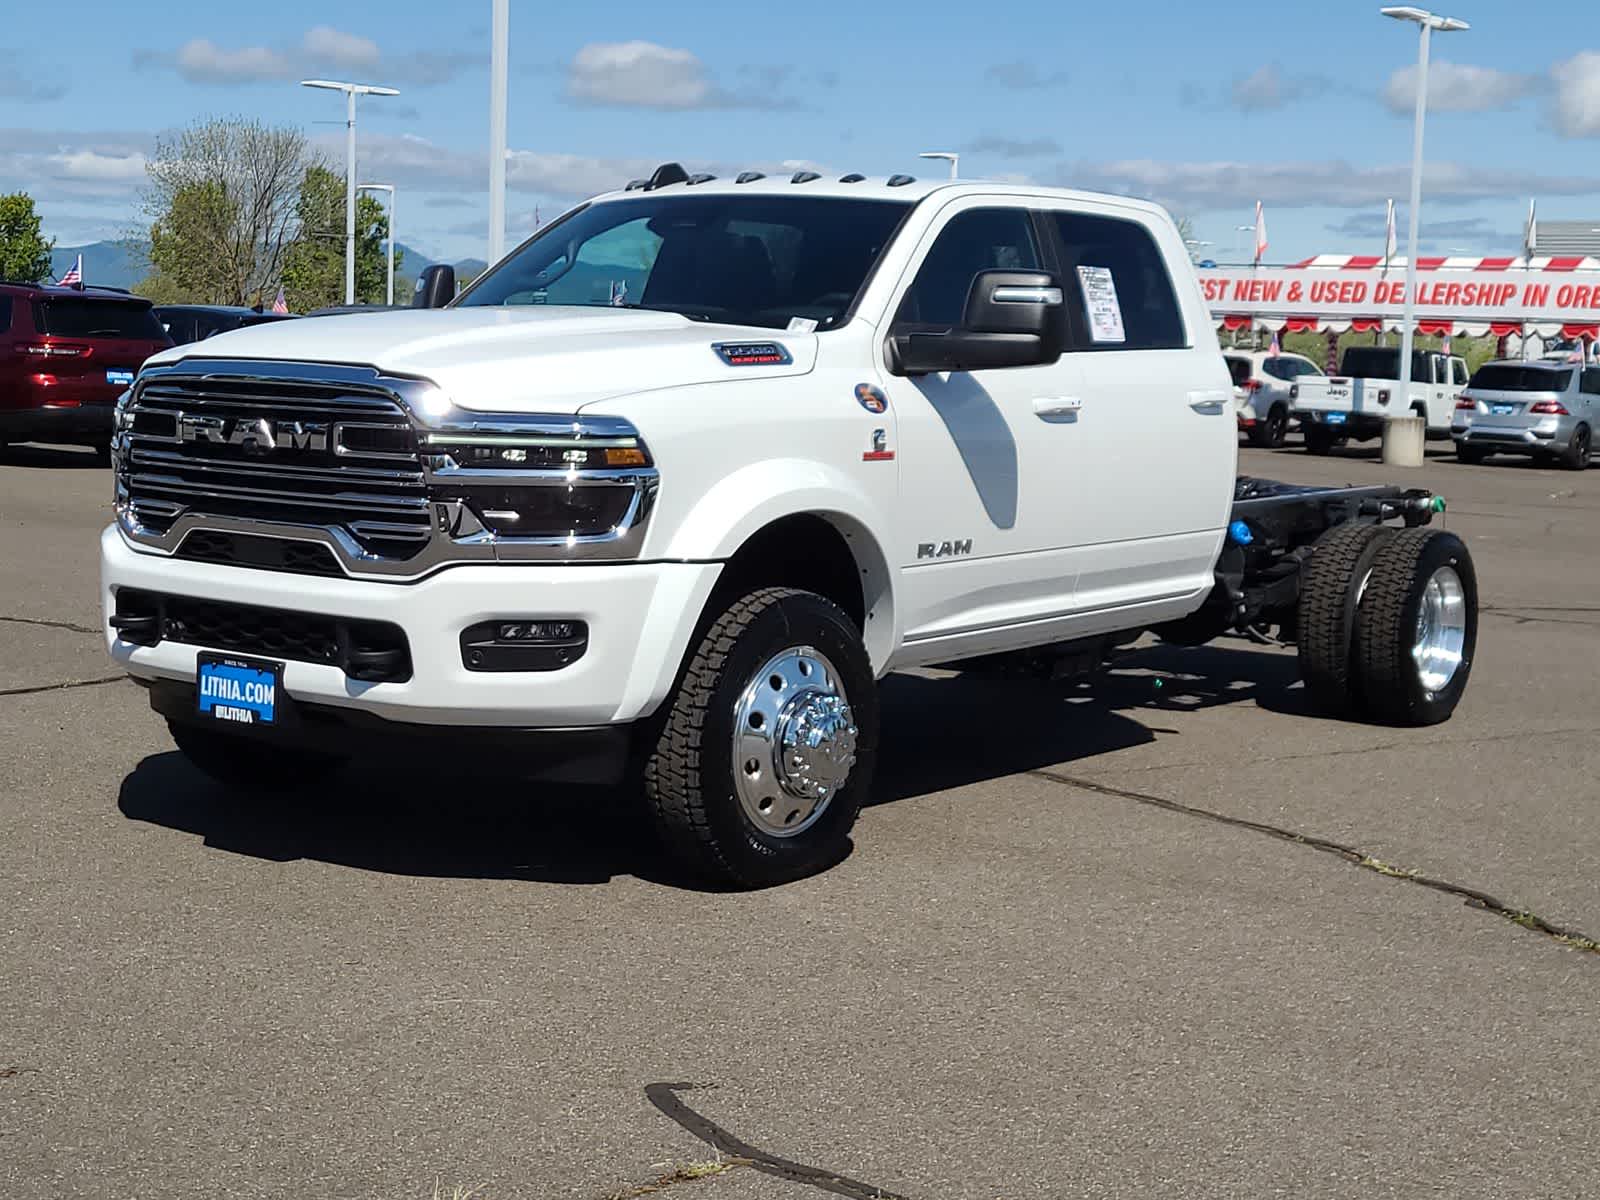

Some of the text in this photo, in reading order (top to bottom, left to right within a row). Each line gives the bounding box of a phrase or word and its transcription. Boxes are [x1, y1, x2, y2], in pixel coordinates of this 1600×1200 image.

[1200, 279, 1230, 301] ST
[1234, 279, 1282, 302] NEW
[1287, 280, 1304, 303] &
[1309, 280, 1368, 304] USED
[1373, 281, 1517, 307] DELERSHIP
[1522, 283, 1550, 307] IN
[1327, 387, 1348, 398] Jeep
[182, 414, 329, 449] RAM
[917, 539, 973, 559] RAM
[200, 674, 275, 706] LITHIA.COM
[224, 705, 253, 724] LITHIA
